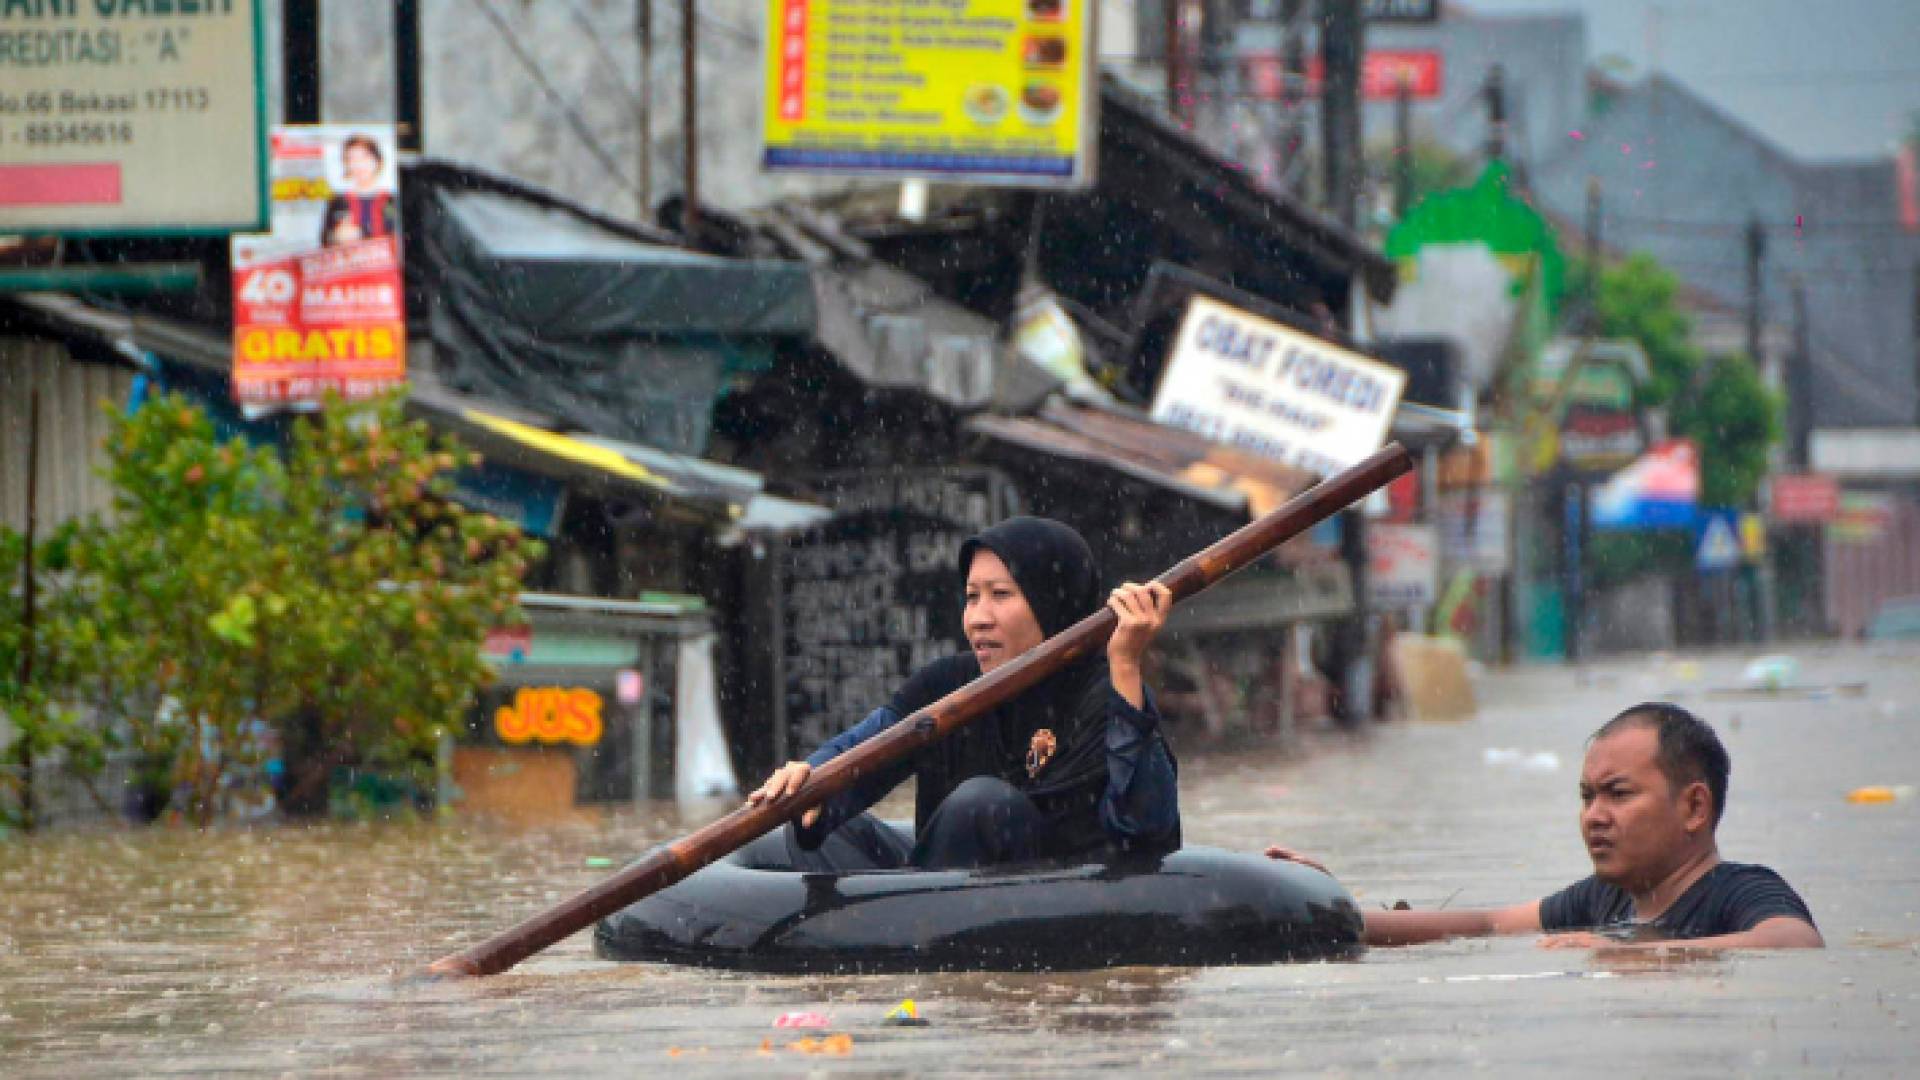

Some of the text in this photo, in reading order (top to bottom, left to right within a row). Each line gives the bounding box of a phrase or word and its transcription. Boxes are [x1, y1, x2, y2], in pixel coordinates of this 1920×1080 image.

[59, 89, 135, 112] Bekasi
[146, 86, 209, 110] 17113
[238, 270, 296, 305] 40
[244, 329, 394, 363] GRATIS
[1196, 314, 1278, 371] OBAT
[495, 687, 604, 745] JUS
